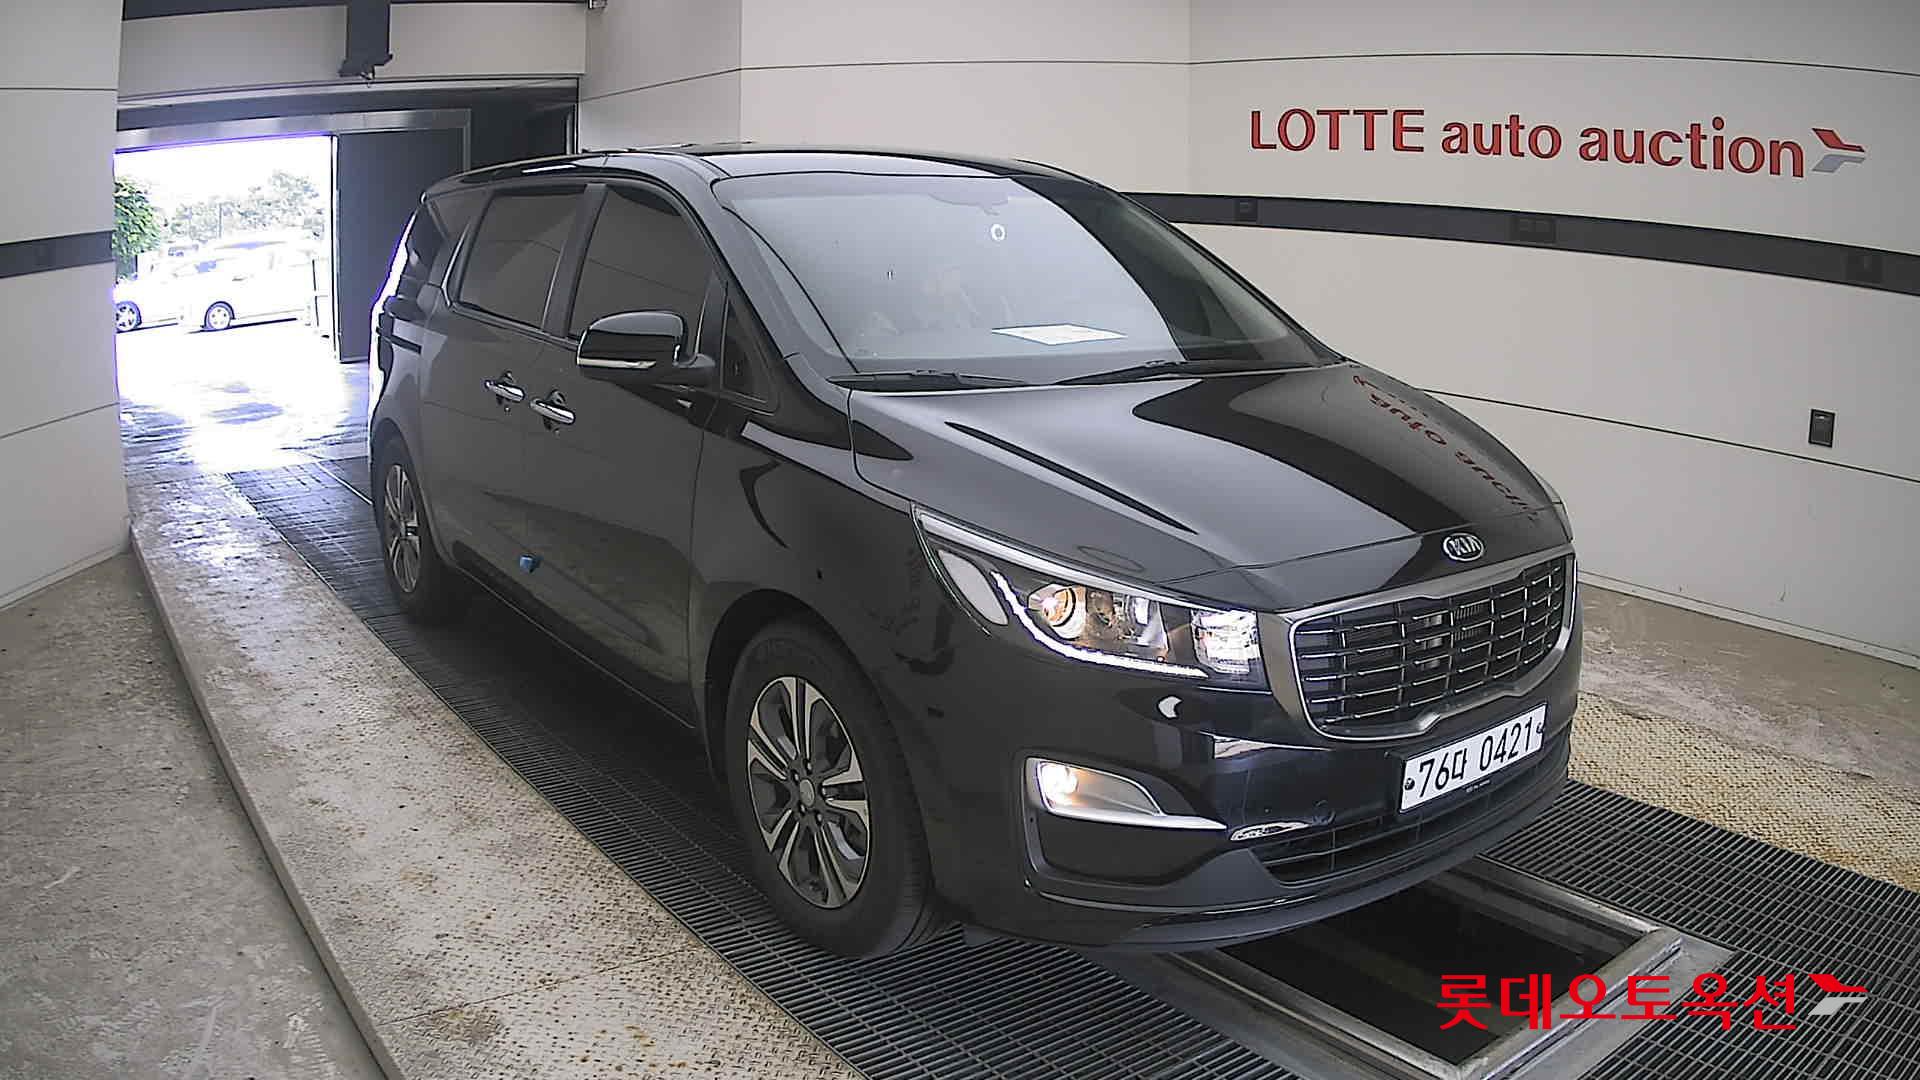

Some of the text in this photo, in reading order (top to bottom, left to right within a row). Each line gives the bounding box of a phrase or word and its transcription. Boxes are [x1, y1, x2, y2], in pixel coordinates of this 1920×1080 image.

[1250, 107, 1805, 178] LOTTE auto auction
[1447, 535, 1481, 556] KIA
[1419, 716, 1533, 798] 76다 0421
